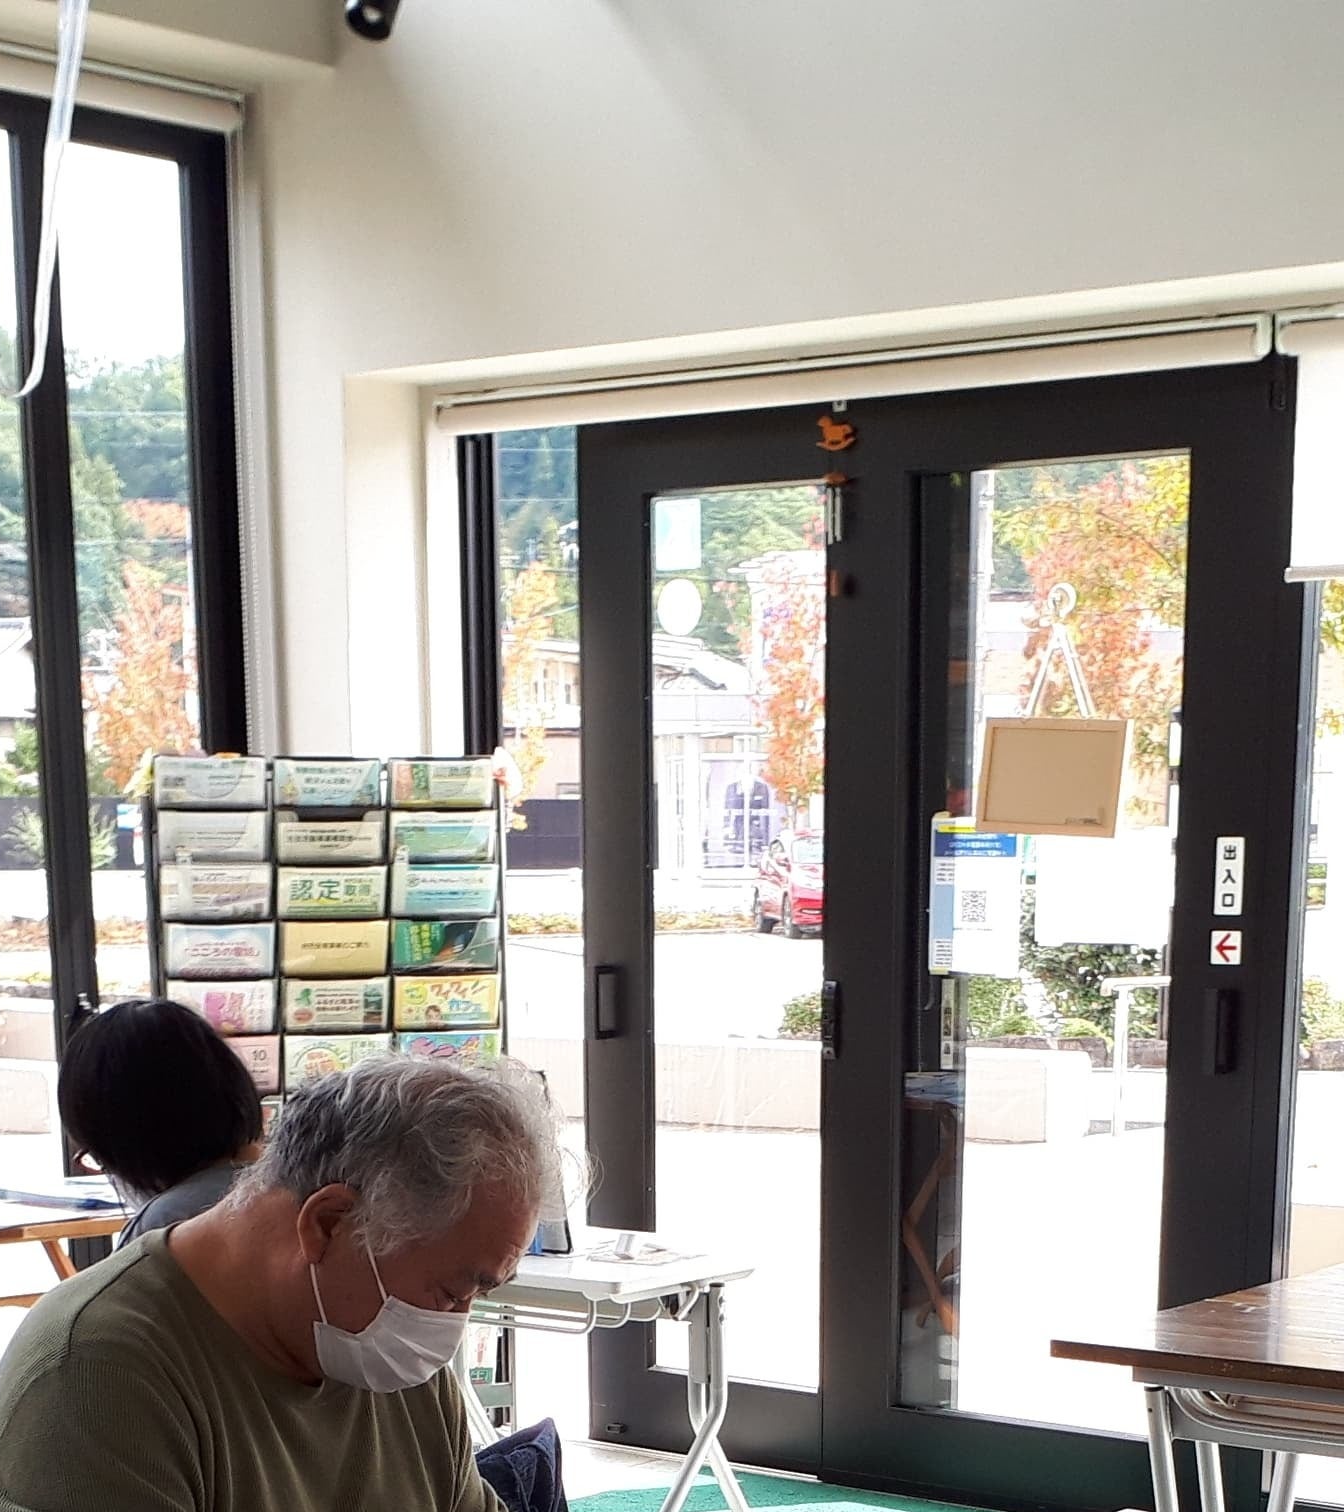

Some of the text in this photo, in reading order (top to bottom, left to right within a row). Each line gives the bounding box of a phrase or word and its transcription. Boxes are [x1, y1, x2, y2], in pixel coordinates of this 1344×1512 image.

[1222, 844, 1237, 907] 出入口
[290, 879, 340, 901] 認定
[252, 1049, 268, 1061] 10
